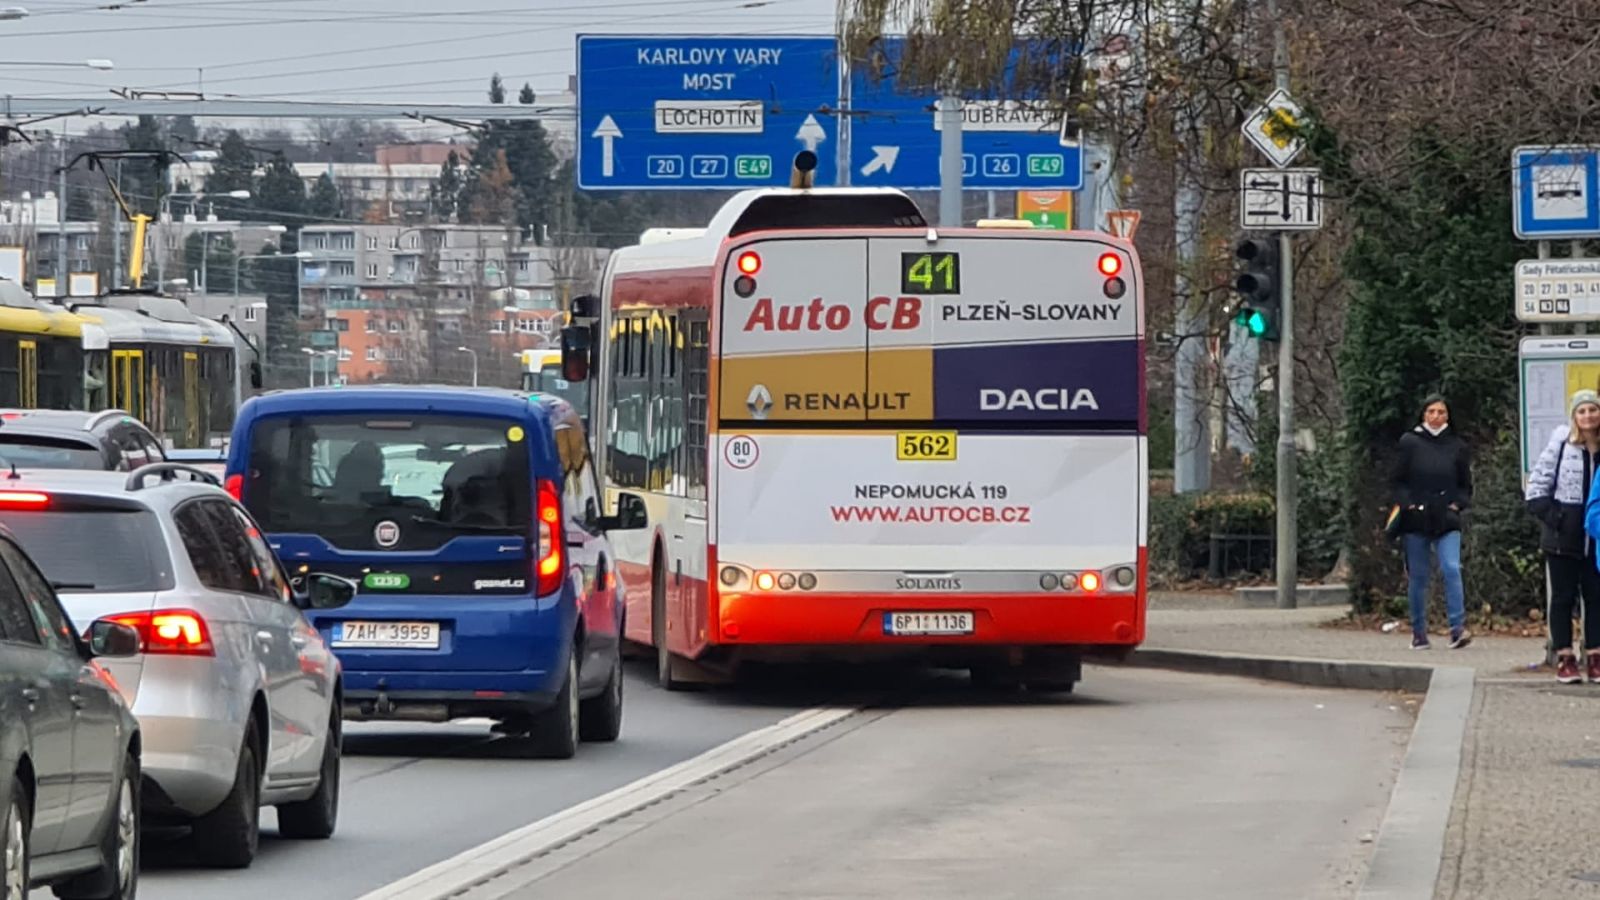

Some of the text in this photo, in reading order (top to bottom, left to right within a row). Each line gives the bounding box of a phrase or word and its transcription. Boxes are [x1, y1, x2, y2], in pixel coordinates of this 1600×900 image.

[637, 48, 782, 65] KARLOVY VARY
[682, 73, 735, 90] MOST
[657, 159, 768, 174] 20 27 E49
[993, 158, 1060, 173] 26 E49
[907, 253, 955, 291] 41
[1523, 265, 1542, 277] Sady
[1541, 283, 1551, 294] 27
[1574, 282, 1585, 293] 34
[743, 296, 1121, 331] Auto CB PLZEŇ-SLOVANY
[784, 388, 1099, 411] RENAULT DACIA
[733, 441, 751, 456] 80
[903, 437, 950, 456] 562
[854, 482, 1007, 500] NEPOMUCKÁ 119
[831, 506, 1031, 523] WWW.AUTOCB.CZ
[895, 578, 962, 590] SOLARIS
[896, 615, 967, 630] 6P1 1136
[346, 624, 431, 641] 7AH 3959
